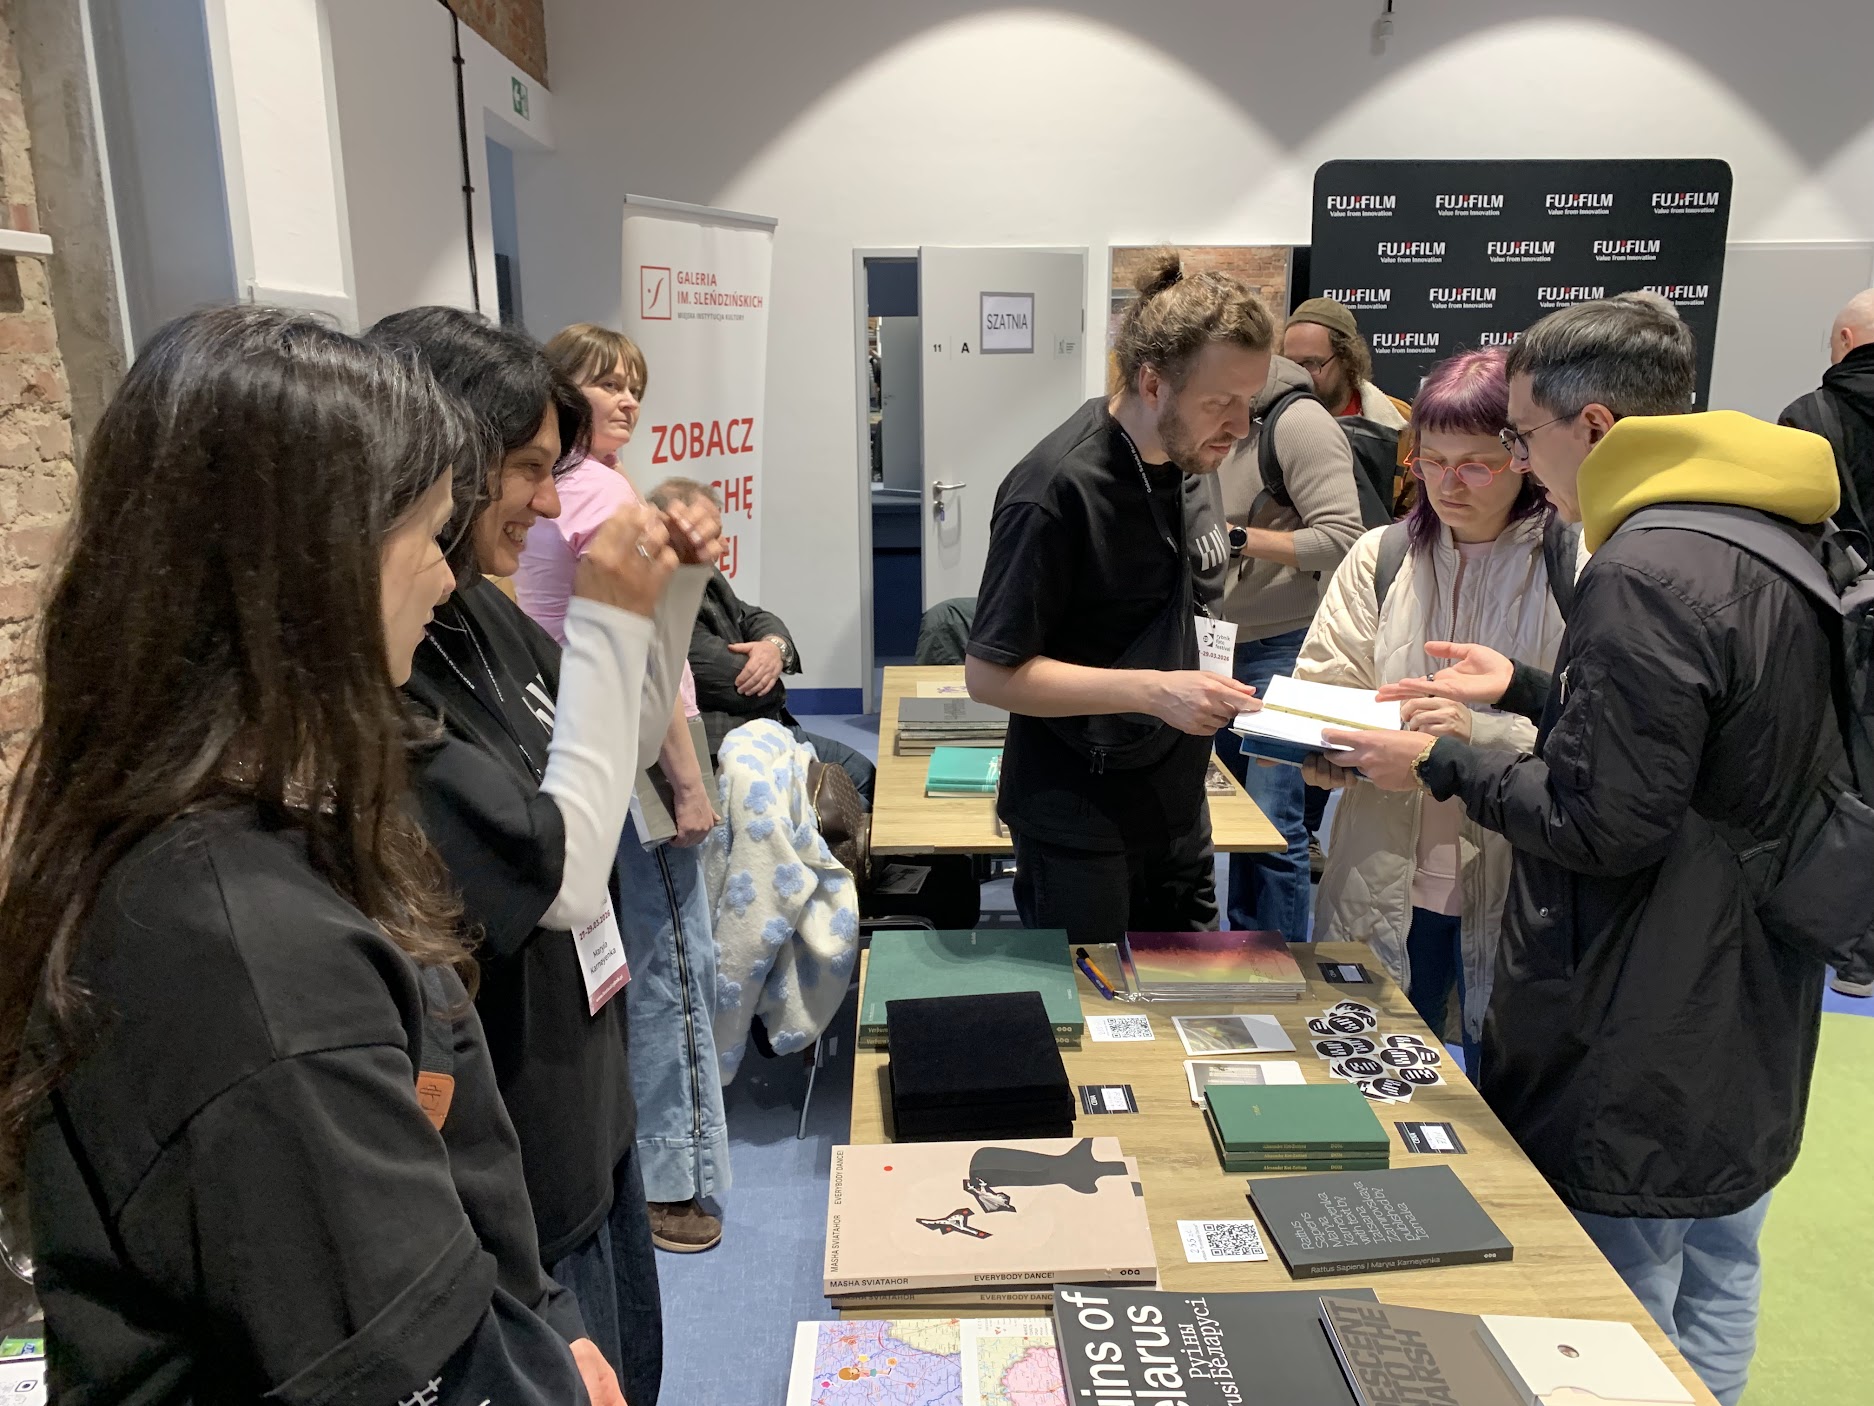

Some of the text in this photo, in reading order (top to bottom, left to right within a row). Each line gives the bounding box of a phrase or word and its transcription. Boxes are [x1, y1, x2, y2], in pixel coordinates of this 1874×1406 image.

[1327, 195, 1396, 209] FUJIFILM
[1436, 194, 1504, 208] FUJIFILM
[1546, 193, 1613, 208] FUJIFILM
[1652, 192, 1719, 206] FUJIFILM
[1378, 242, 1446, 256] FUJIFILM
[1487, 241, 1555, 255] FUJIFILM
[1593, 240, 1660, 254] FUJIFILM
[677, 271, 717, 286] GALERIA
[678, 290, 763, 308] IM. SLEŃDZIŃSKICH
[1323, 288, 1391, 302] FUJIFILM
[1429, 288, 1496, 302] FUJIFILM
[1538, 286, 1604, 300] FUJIFILM
[696, 313, 724, 322] INSTYTUCJA
[986, 314, 1028, 330] SZATNIA
[1372, 332, 1439, 346] FUJIFILM
[1480, 332, 1522, 345] FUJIF
[933, 342, 970, 354] 11 A
[652, 417, 754, 464] ZOBACZ
[1216, 644, 1230, 652] festival
[834, 1172, 843, 1205] EVERYBODY
[1334, 1196, 1371, 1245] with text by
[832, 1215, 840, 1249] SVIATAHOR
[1291, 1220, 1314, 1250] Rattus
[1300, 1212, 1328, 1249] Sapiens
[830, 1250, 839, 1272] MASHA
[1311, 1266, 1335, 1274] Rattus
[1336, 1264, 1365, 1272] Sapiens
[1398, 1257, 1440, 1266] Karneyenka
[862, 1278, 908, 1286] SVIATAHOR
[1060, 1290, 1114, 1331] of
[1185, 1297, 1234, 1379] Беларусі
[1178, 1324, 1210, 1378] Руіны
[1328, 1300, 1401, 1406] ESCENT
[1357, 1307, 1430, 1406] TO THE
[1392, 1328, 1459, 1406] ARSH
